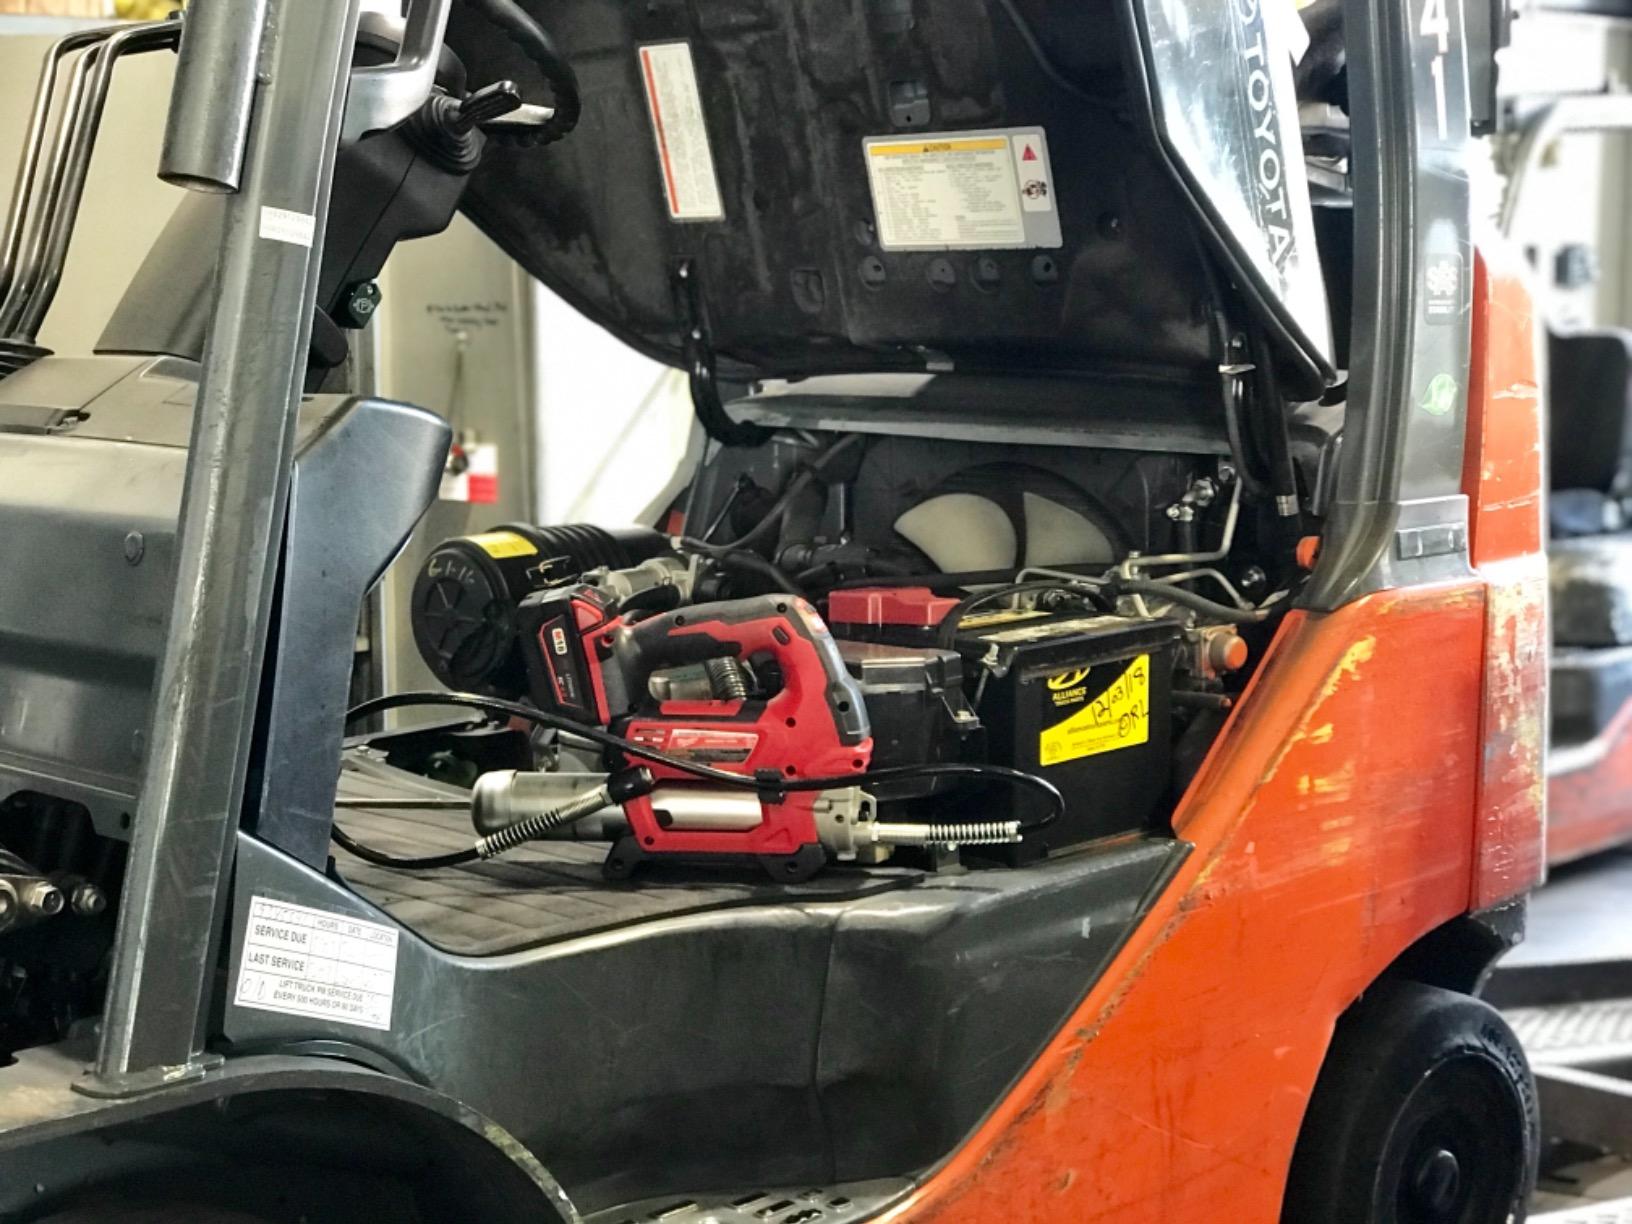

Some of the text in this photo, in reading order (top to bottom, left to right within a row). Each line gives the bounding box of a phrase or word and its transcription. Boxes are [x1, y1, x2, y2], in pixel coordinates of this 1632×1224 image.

[1244, 32, 1292, 266] TOYOTA
[255, 924, 307, 944] SERVICE DUE
[247, 951, 305, 972] LAST SERVICE
